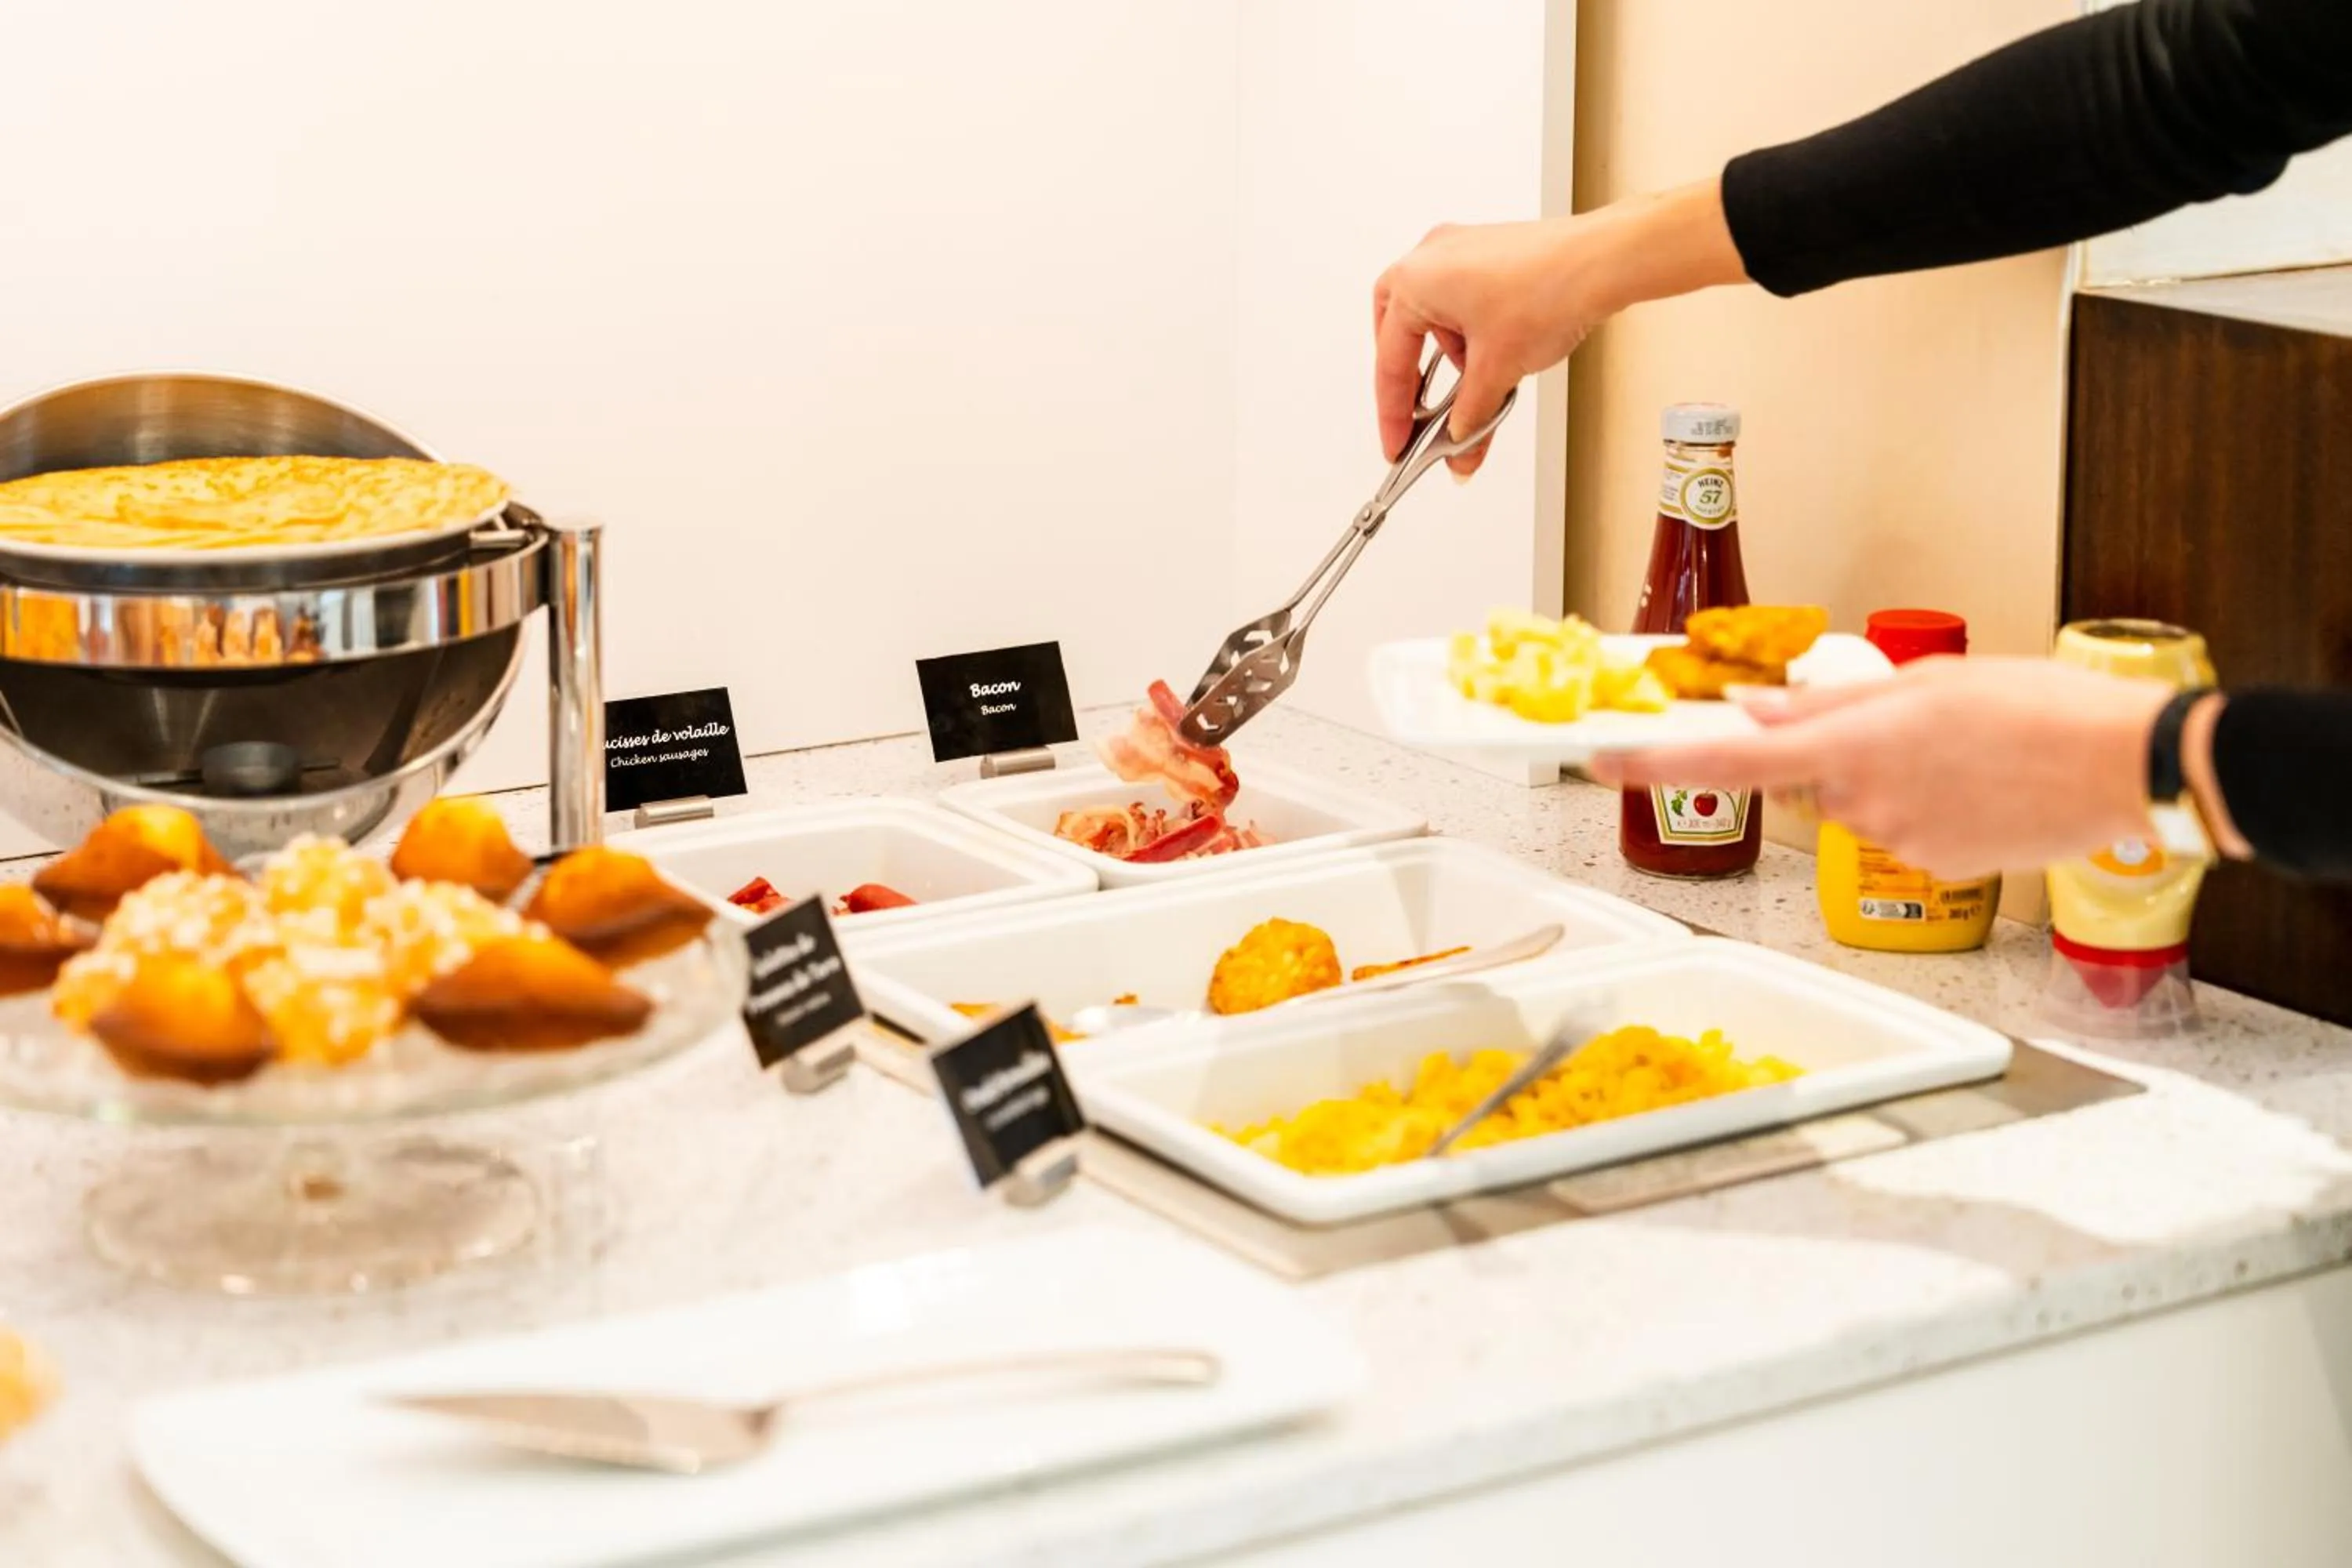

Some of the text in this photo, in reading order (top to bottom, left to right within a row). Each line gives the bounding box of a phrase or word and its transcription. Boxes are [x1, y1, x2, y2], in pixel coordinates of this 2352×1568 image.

[1697, 477, 1723, 488] HEINZ
[1699, 490, 1722, 504] 57
[969, 681, 1021, 698] Bacon
[980, 703, 1017, 716] Bacon
[602, 722, 730, 750] ucisses de volaille
[610, 747, 710, 768] Chicken sausages
